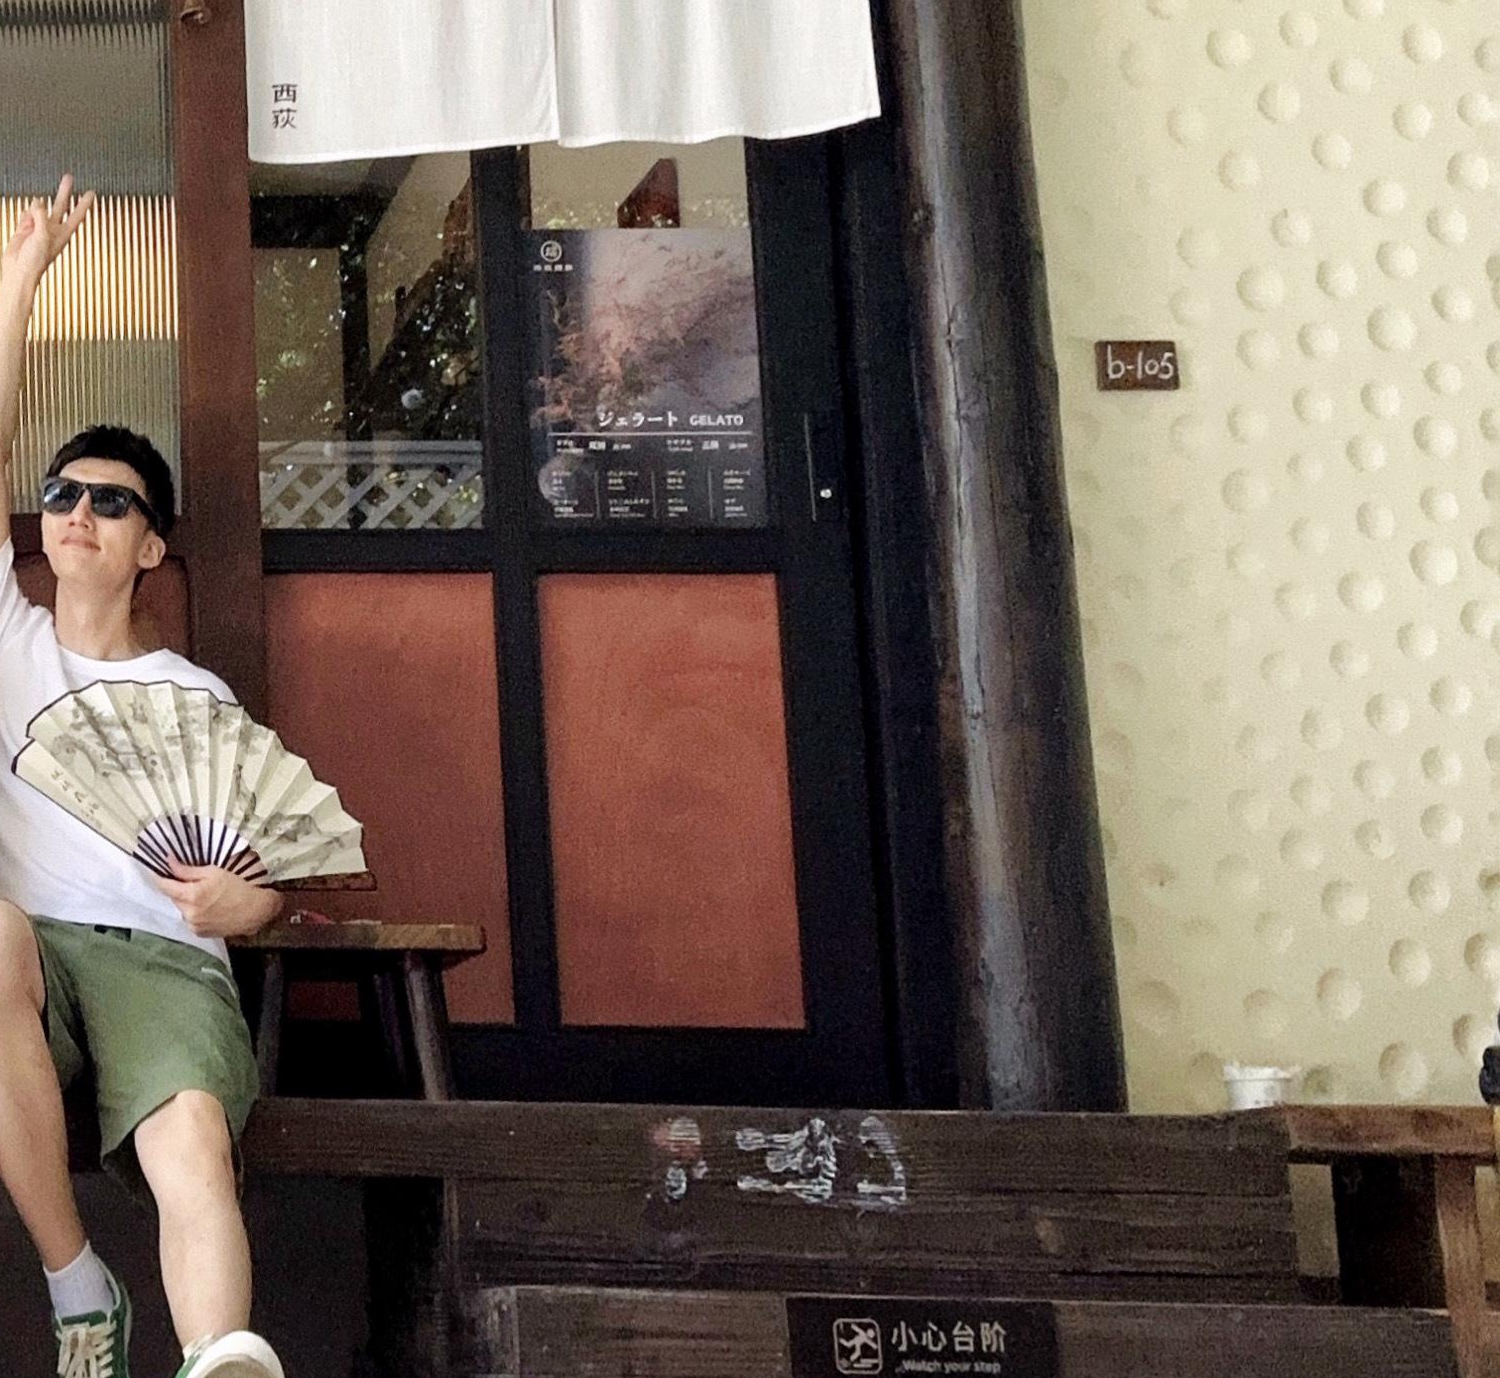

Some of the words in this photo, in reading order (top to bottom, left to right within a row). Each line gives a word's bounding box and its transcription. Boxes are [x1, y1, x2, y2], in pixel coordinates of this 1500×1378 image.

[271, 83, 298, 129] 西荻
[599, 410, 678, 428] ジェラート
[689, 414, 744, 427] GELATO
[891, 1320, 1007, 1353] 小心台阶
[902, 1359, 941, 1373] Watch
[944, 1361, 971, 1374] your
[973, 1361, 1001, 1374] step
